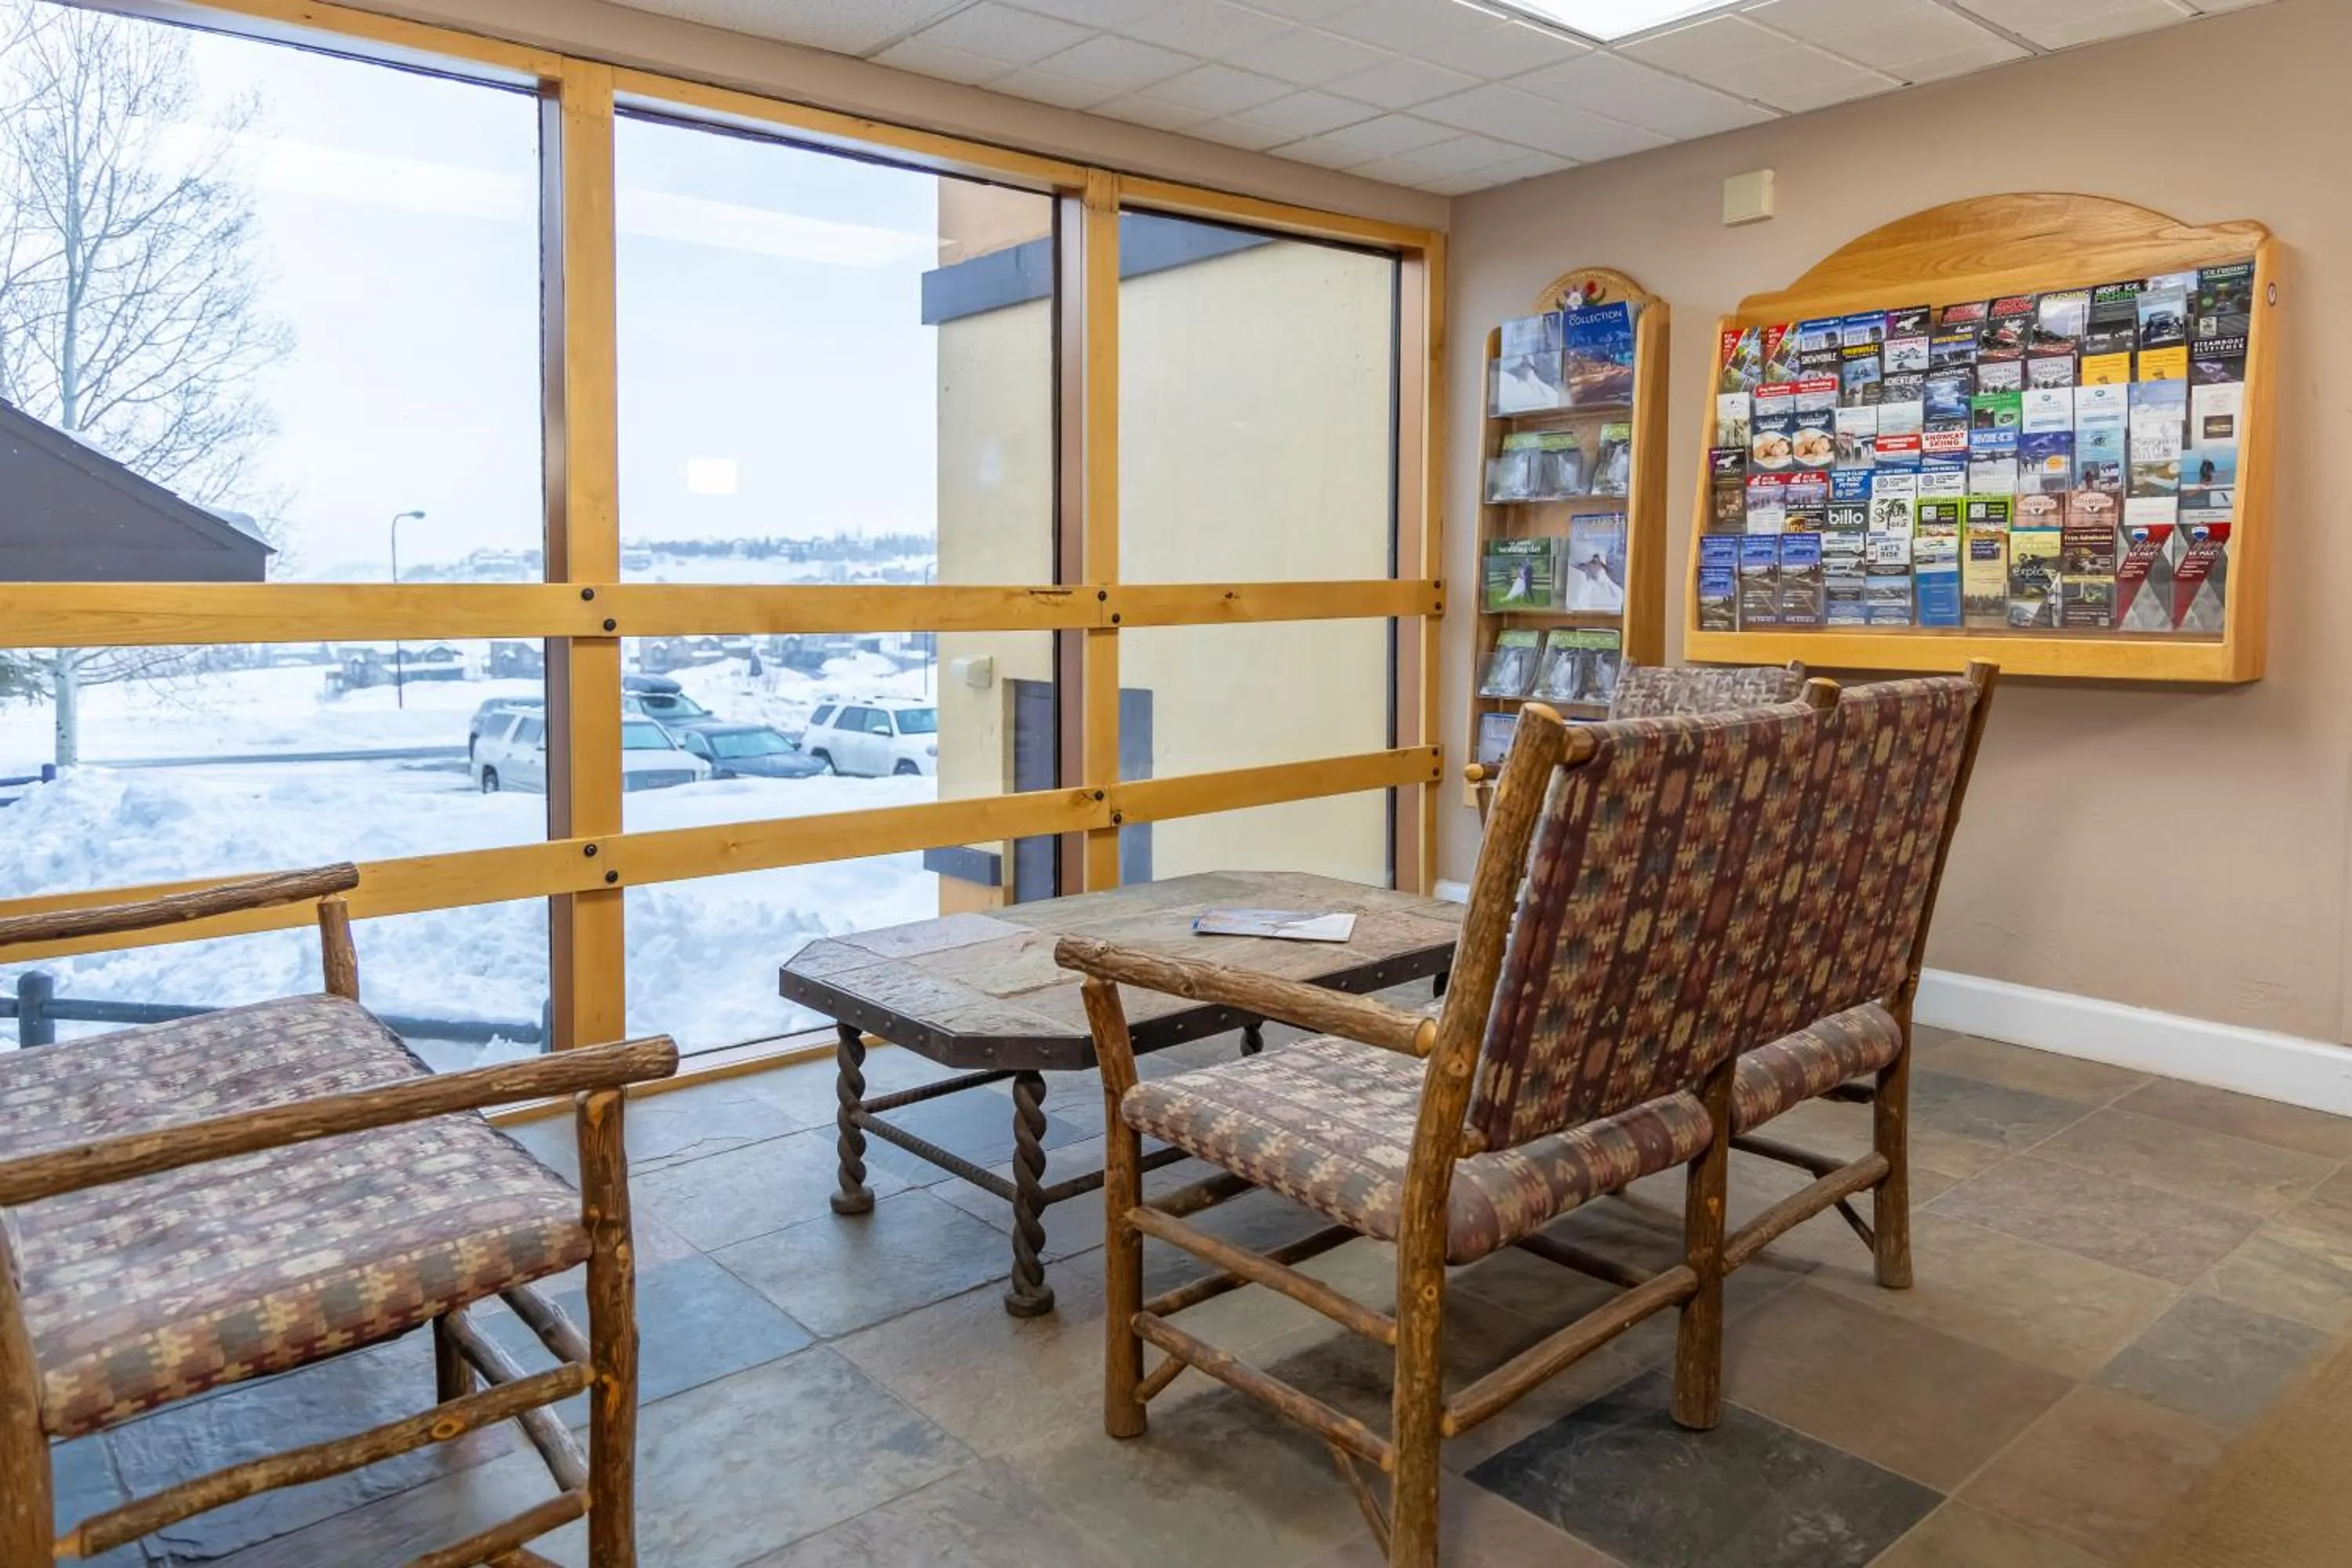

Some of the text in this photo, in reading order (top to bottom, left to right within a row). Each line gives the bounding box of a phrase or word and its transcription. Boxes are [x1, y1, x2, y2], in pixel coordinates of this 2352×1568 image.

[1569, 310, 1622, 326] COLLECTION
[2194, 338, 2244, 347] STEAMBOAT
[1925, 432, 1965, 441] SNOWCAT
[1828, 510, 1864, 524] billo
[2013, 568, 2056, 579] explore
